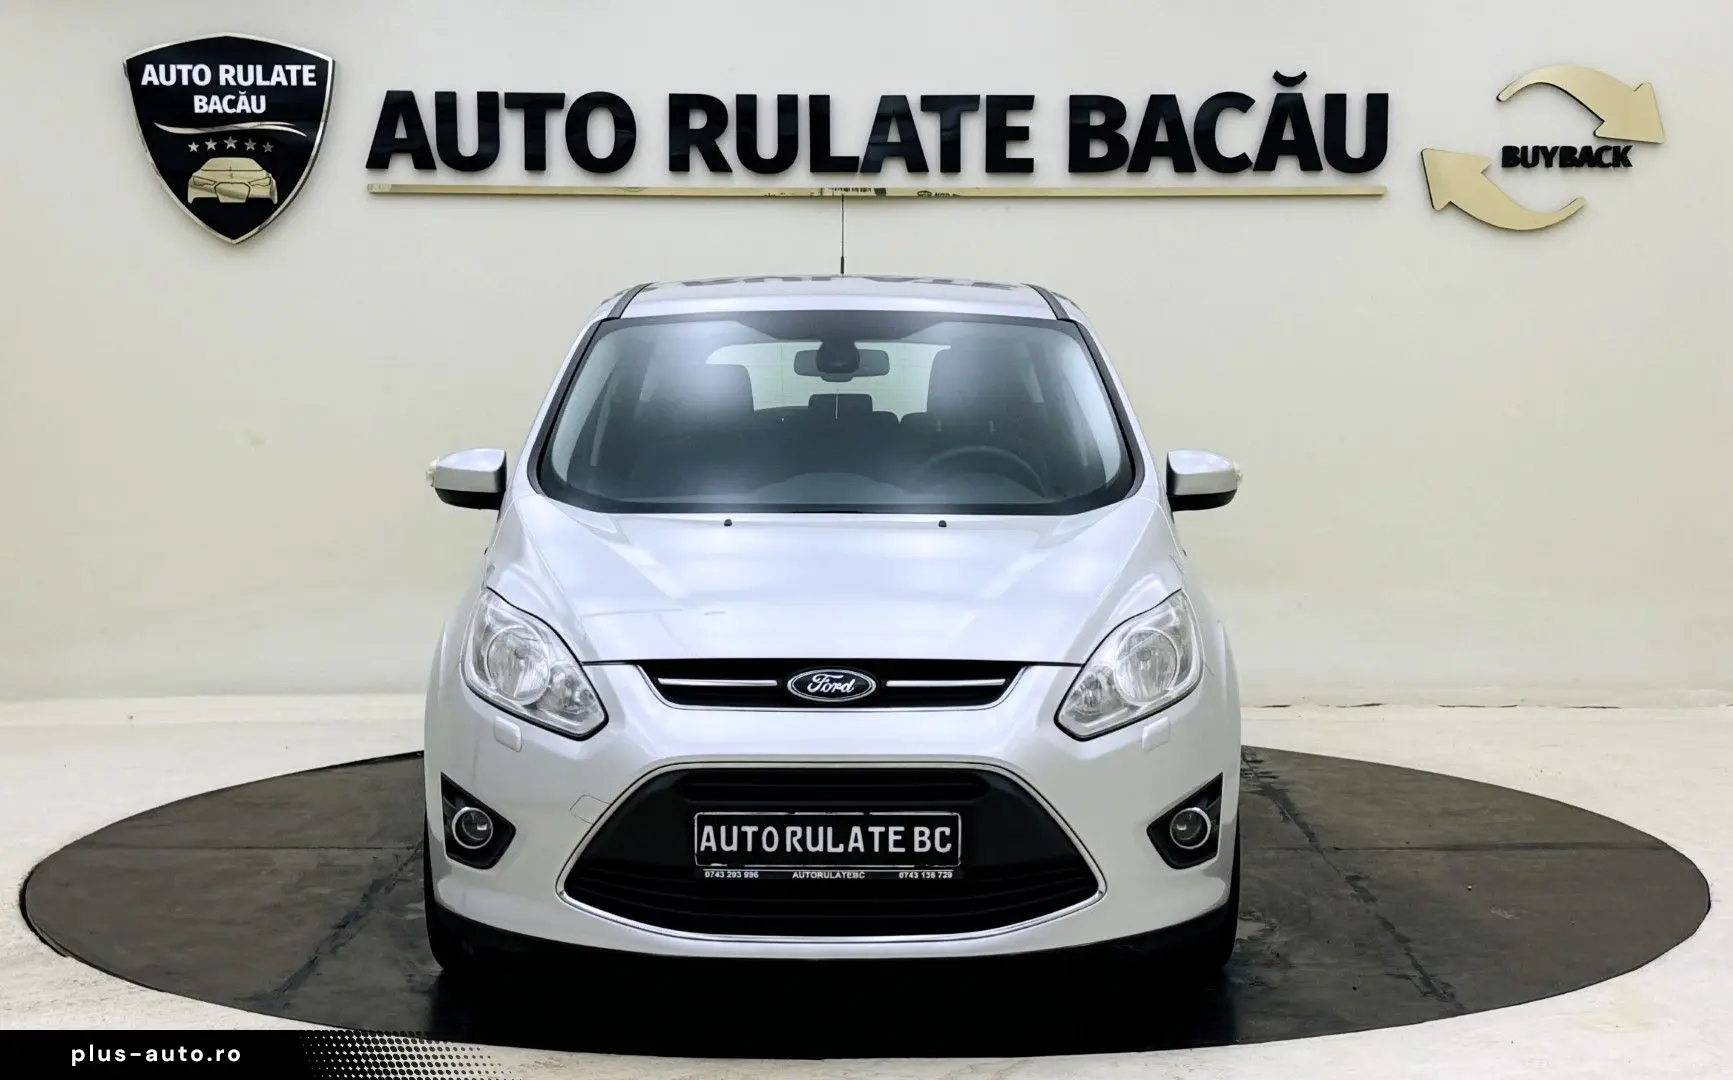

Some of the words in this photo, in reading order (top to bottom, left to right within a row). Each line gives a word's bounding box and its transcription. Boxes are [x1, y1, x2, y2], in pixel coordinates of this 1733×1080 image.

[141, 64, 212, 86] AUTO
[219, 64, 317, 86] RULATE
[193, 90, 267, 114] BACĂU
[365, 90, 637, 174] AUTO
[668, 93, 1035, 175] RULATE
[1068, 70, 1389, 174] BACĂU
[1501, 145, 1633, 168] BUYBACK
[807, 672, 856, 694] Ford
[913, 826, 952, 853] BC
[704, 871, 725, 879] 0743
[726, 871, 742, 879] 293
[792, 871, 866, 879] AUTORULATEBC
[898, 871, 919, 879] 0743
